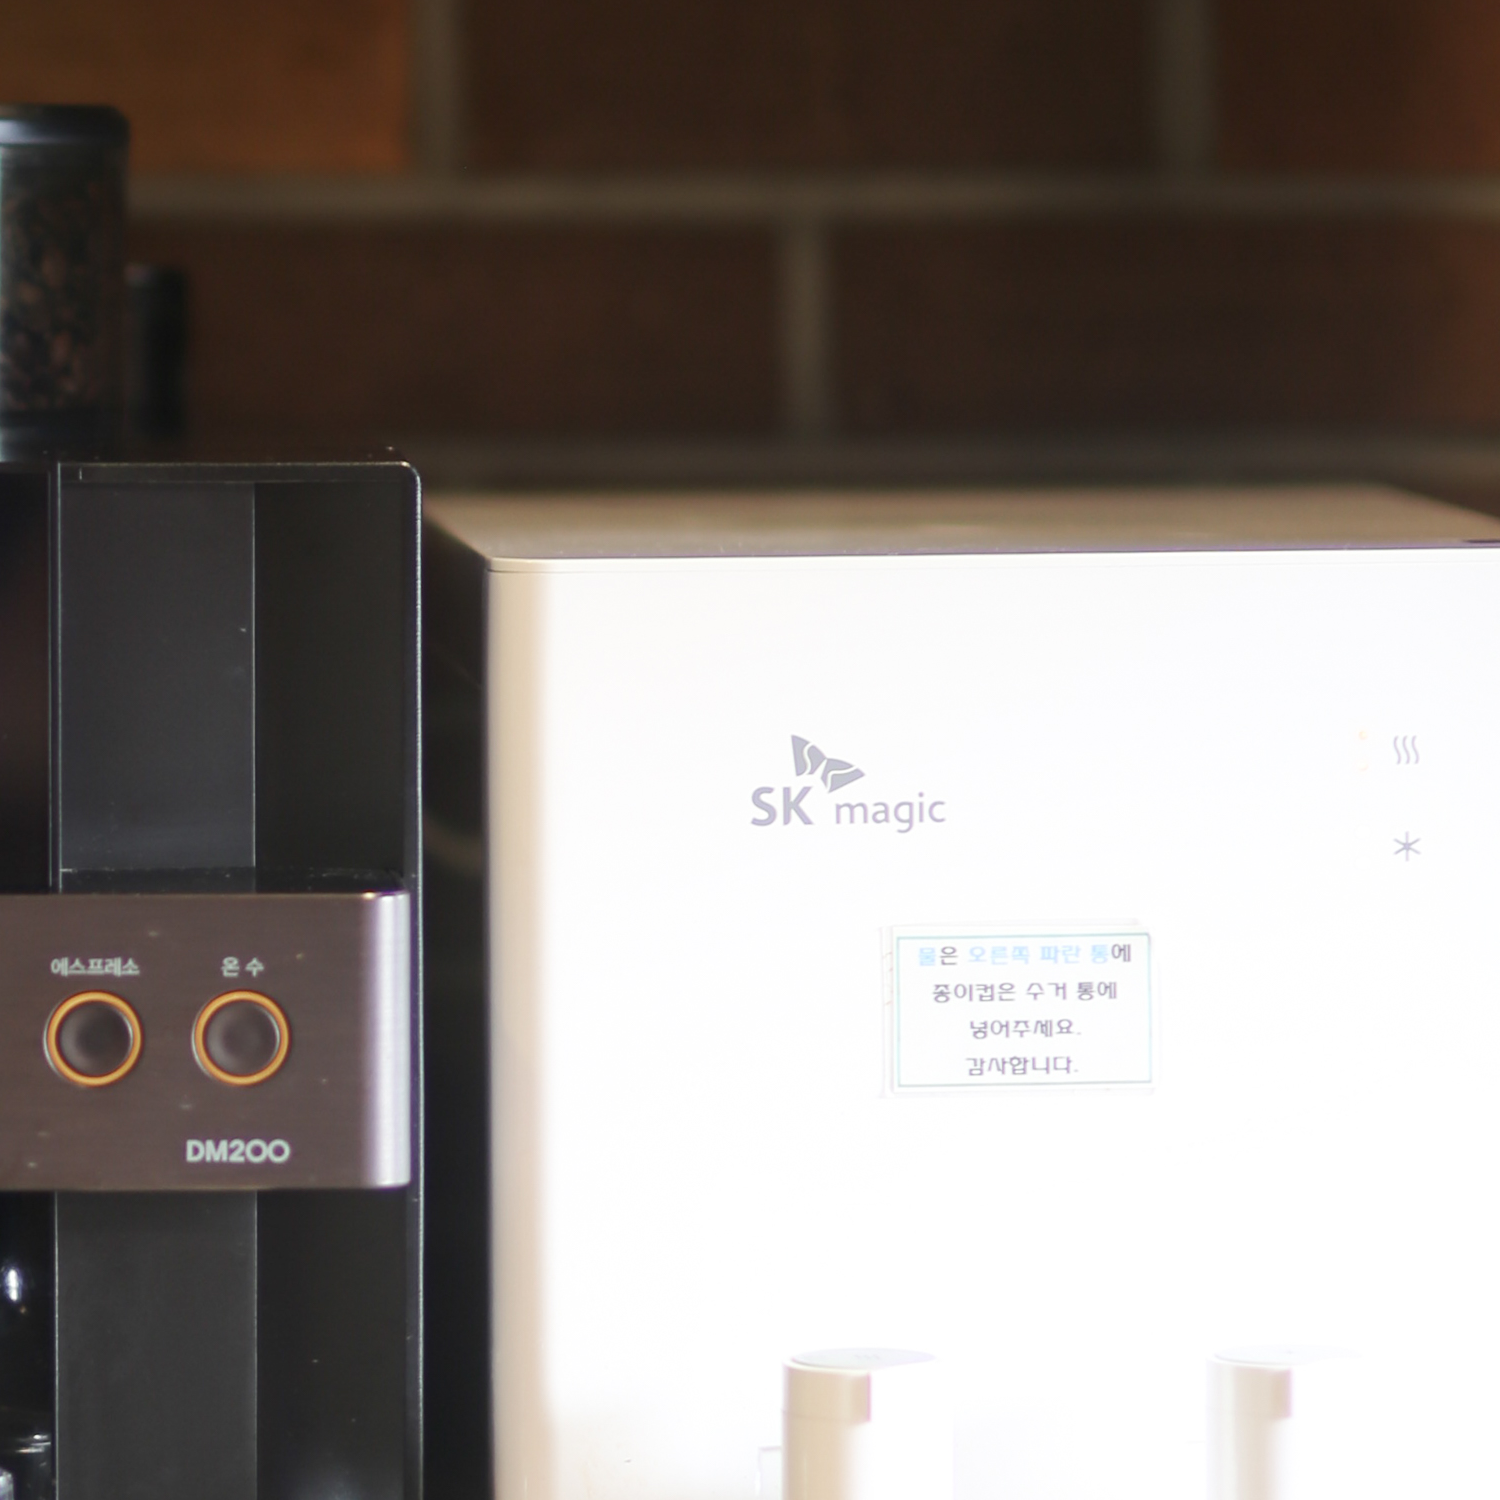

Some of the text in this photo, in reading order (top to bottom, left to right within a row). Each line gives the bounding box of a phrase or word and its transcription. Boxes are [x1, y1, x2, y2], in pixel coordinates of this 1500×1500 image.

[750, 786, 947, 834] SK magic
[918, 943, 1131, 966] 물은 오른쪽 파란 통에
[50, 957, 140, 977] 에스프레소
[932, 981, 1117, 1003] 종이컵은 수거 통에
[969, 1019, 1082, 1040] 넣어주세요.
[965, 1056, 1078, 1076] 감사합니다.
[185, 1138, 291, 1164] DM200
